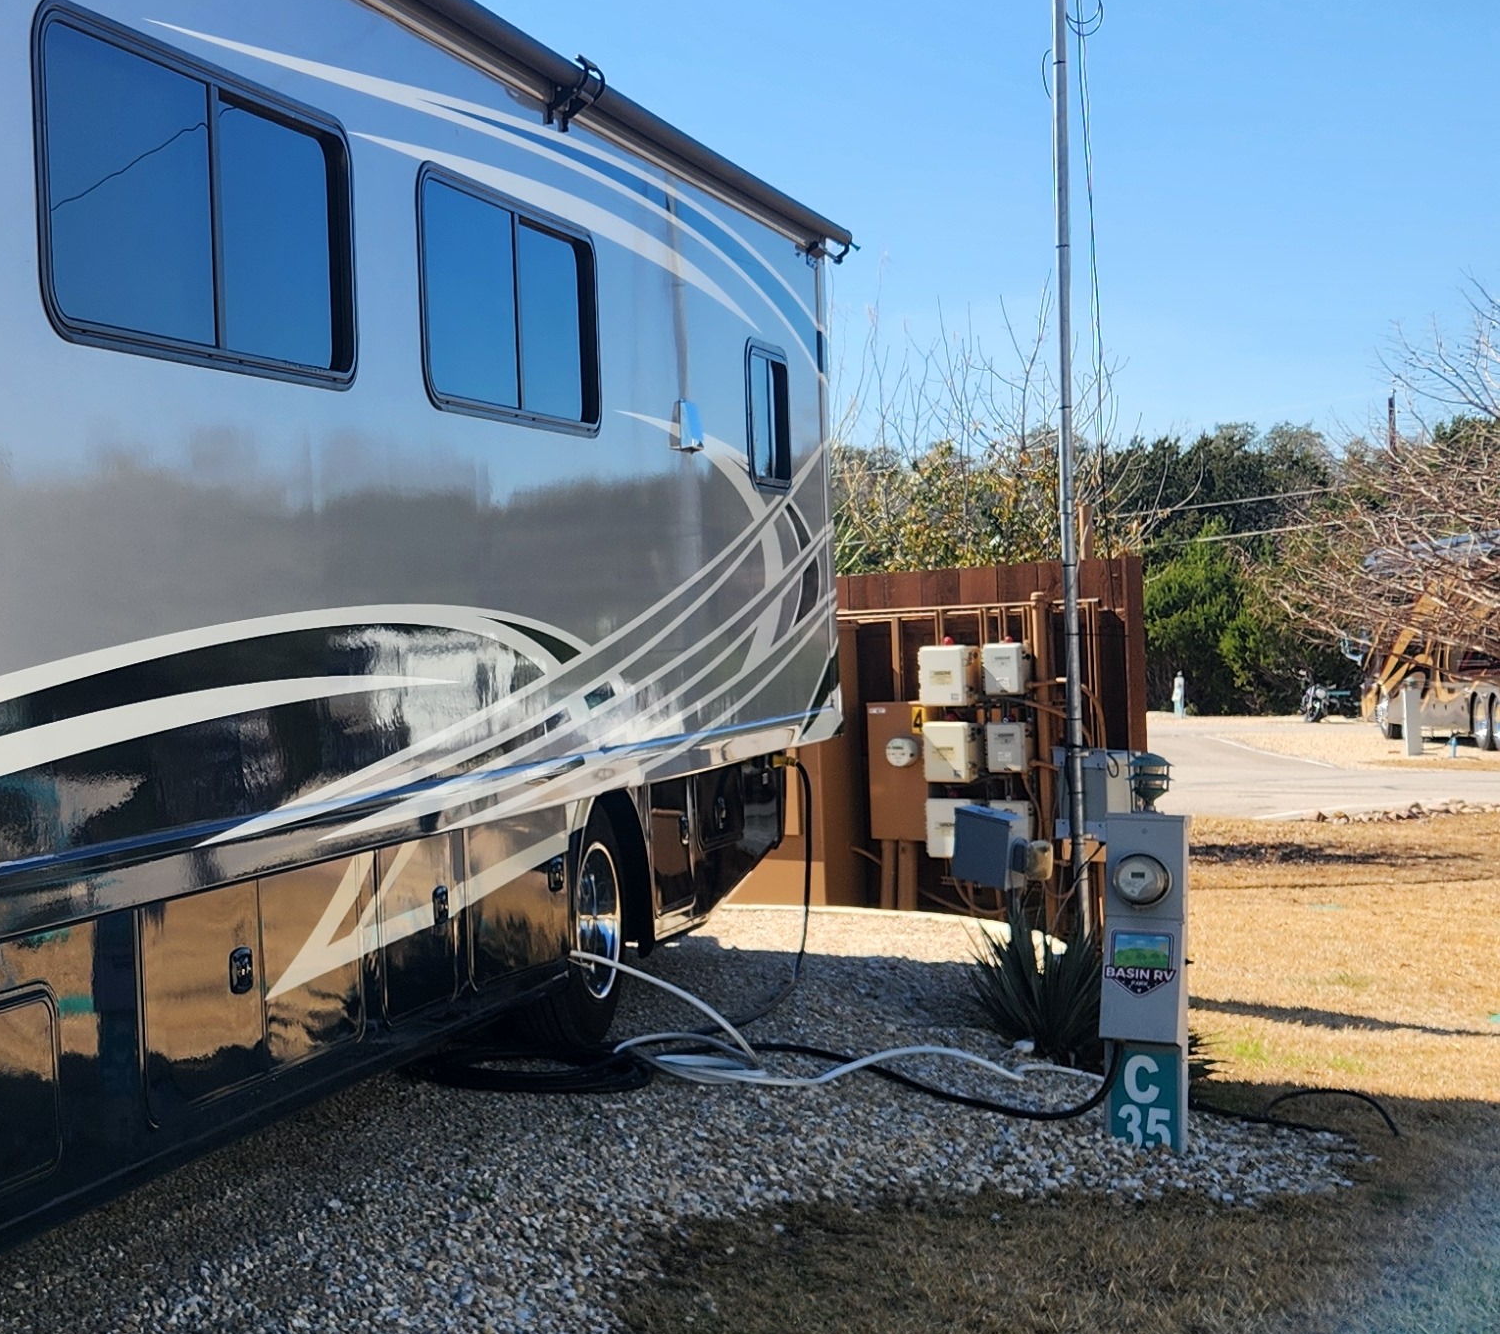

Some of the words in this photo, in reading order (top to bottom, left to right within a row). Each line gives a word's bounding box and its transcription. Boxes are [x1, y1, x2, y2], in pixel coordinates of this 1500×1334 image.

[1106, 967, 1150, 980] BASIN
[1154, 970, 1174, 981] RV
[1123, 1054, 1160, 1104] C
[1116, 1103, 1172, 1149] 35
